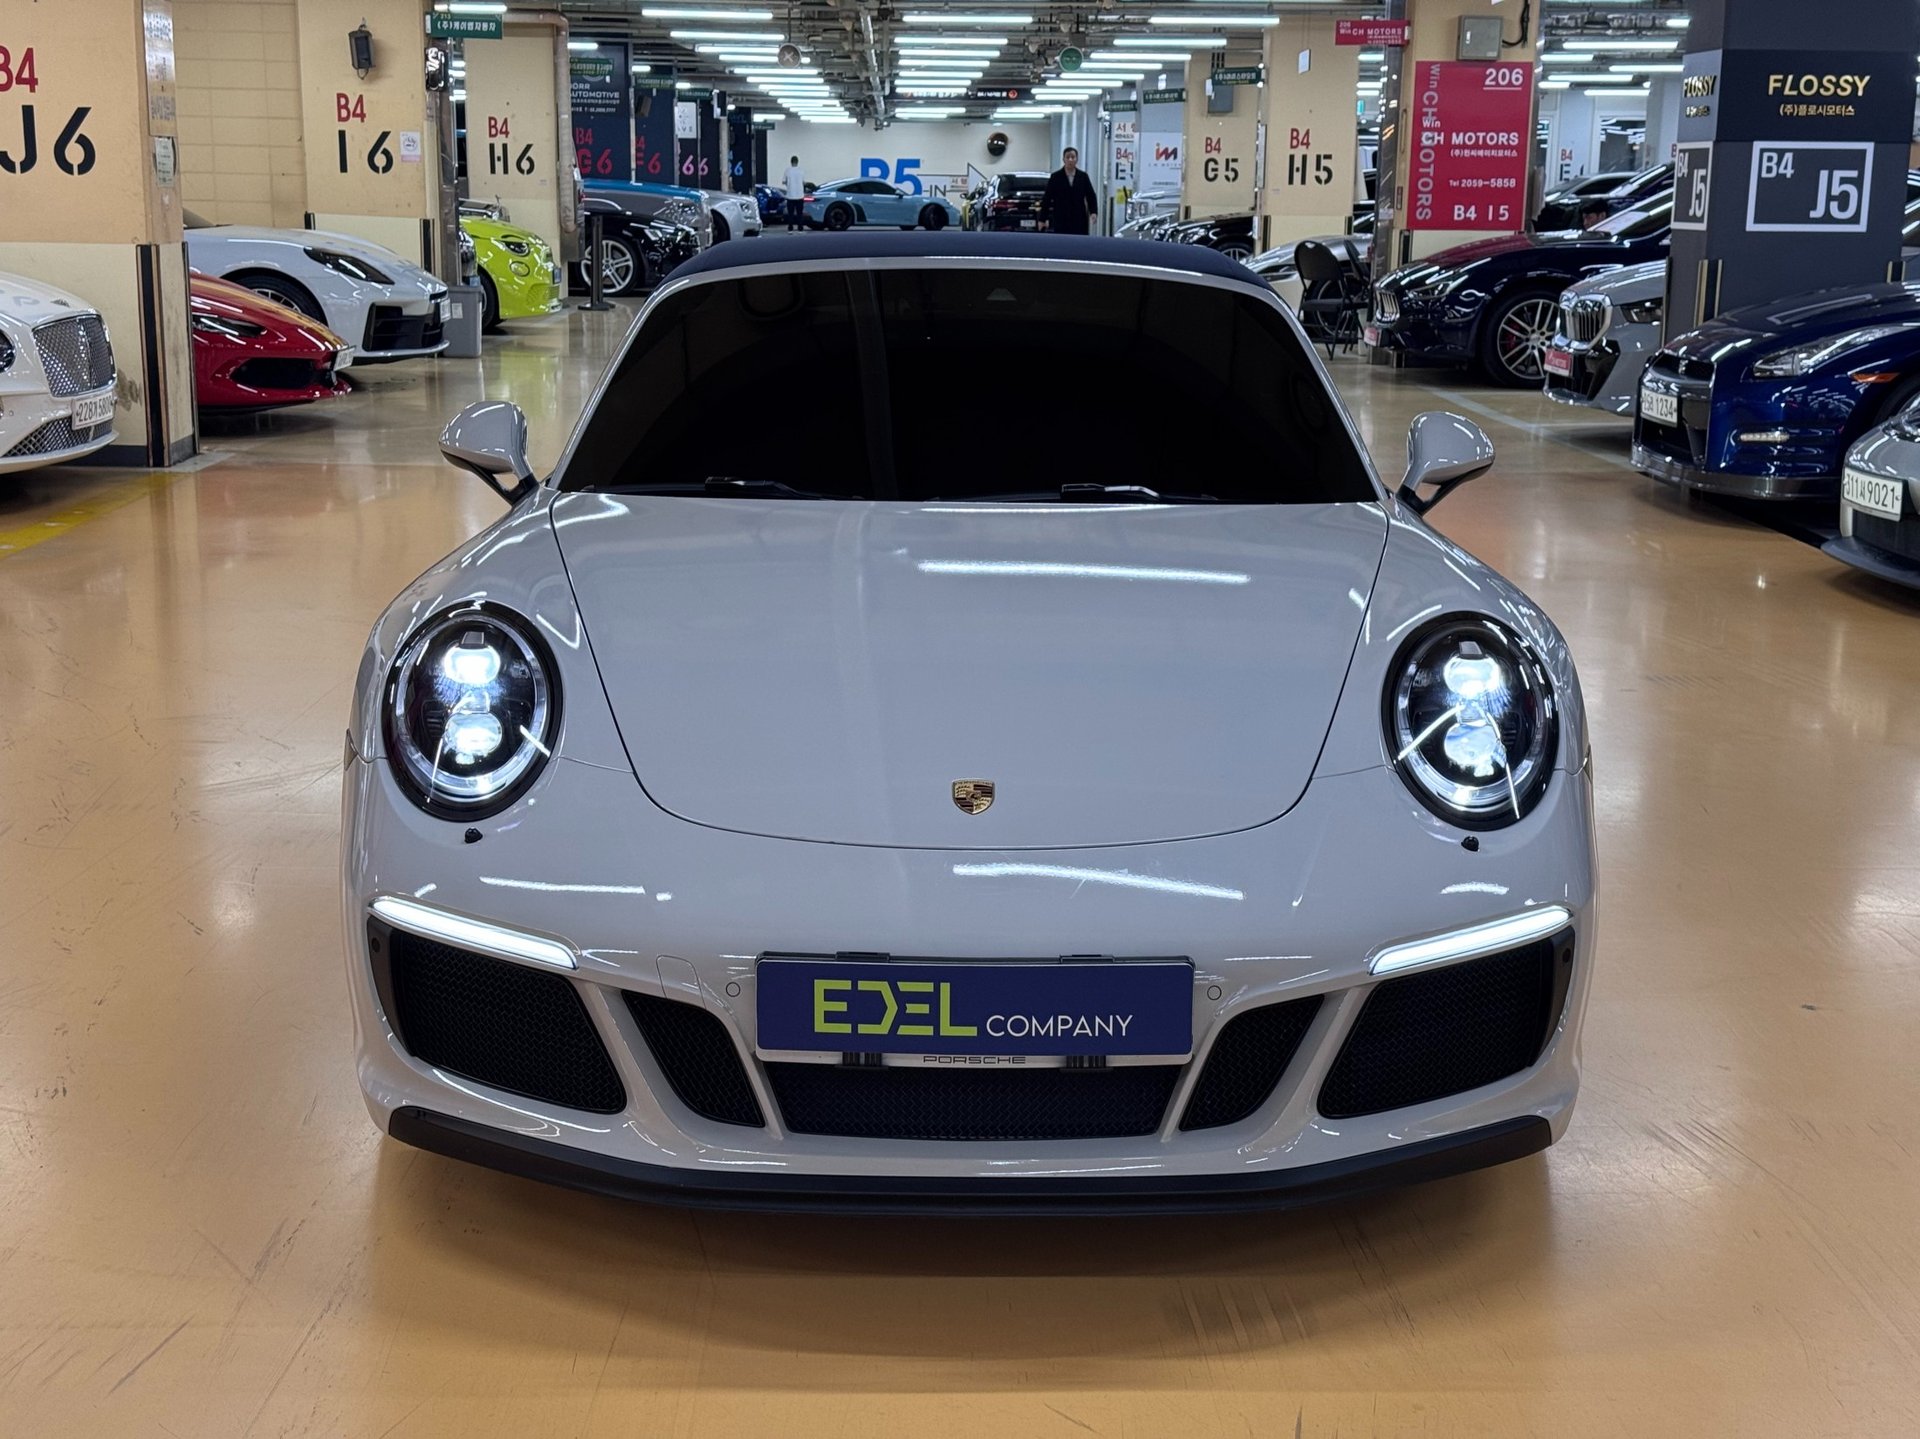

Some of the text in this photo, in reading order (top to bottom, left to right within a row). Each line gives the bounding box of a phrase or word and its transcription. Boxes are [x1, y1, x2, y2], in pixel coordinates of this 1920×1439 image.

[0, 45, 39, 93] B4
[1485, 68, 1524, 86] 206
[1684, 75, 1717, 98] FLOSSY
[1768, 74, 1871, 97] FLOSSY
[336, 93, 366, 123] B4
[1780, 103, 1855, 116] (주)플로시모터스
[488, 116, 510, 138] B4
[1422, 118, 1441, 128] Win
[576, 127, 593, 145] B4
[1205, 137, 1222, 154] B4
[1290, 128, 1311, 149] B4
[1421, 132, 1519, 145] CH MOTORS
[1561, 149, 1573, 161] B4
[1678, 152, 1689, 178] B4
[1761, 152, 1795, 178] B4
[1461, 178, 1516, 188] 2059-5858
[1689, 168, 1706, 217] J5
[1809, 170, 1859, 219] J5
[1454, 205, 1477, 220] B4
[814, 979, 1133, 1038] EDEL COMPANY
[923, 1055, 1027, 1065] PORSCHE
